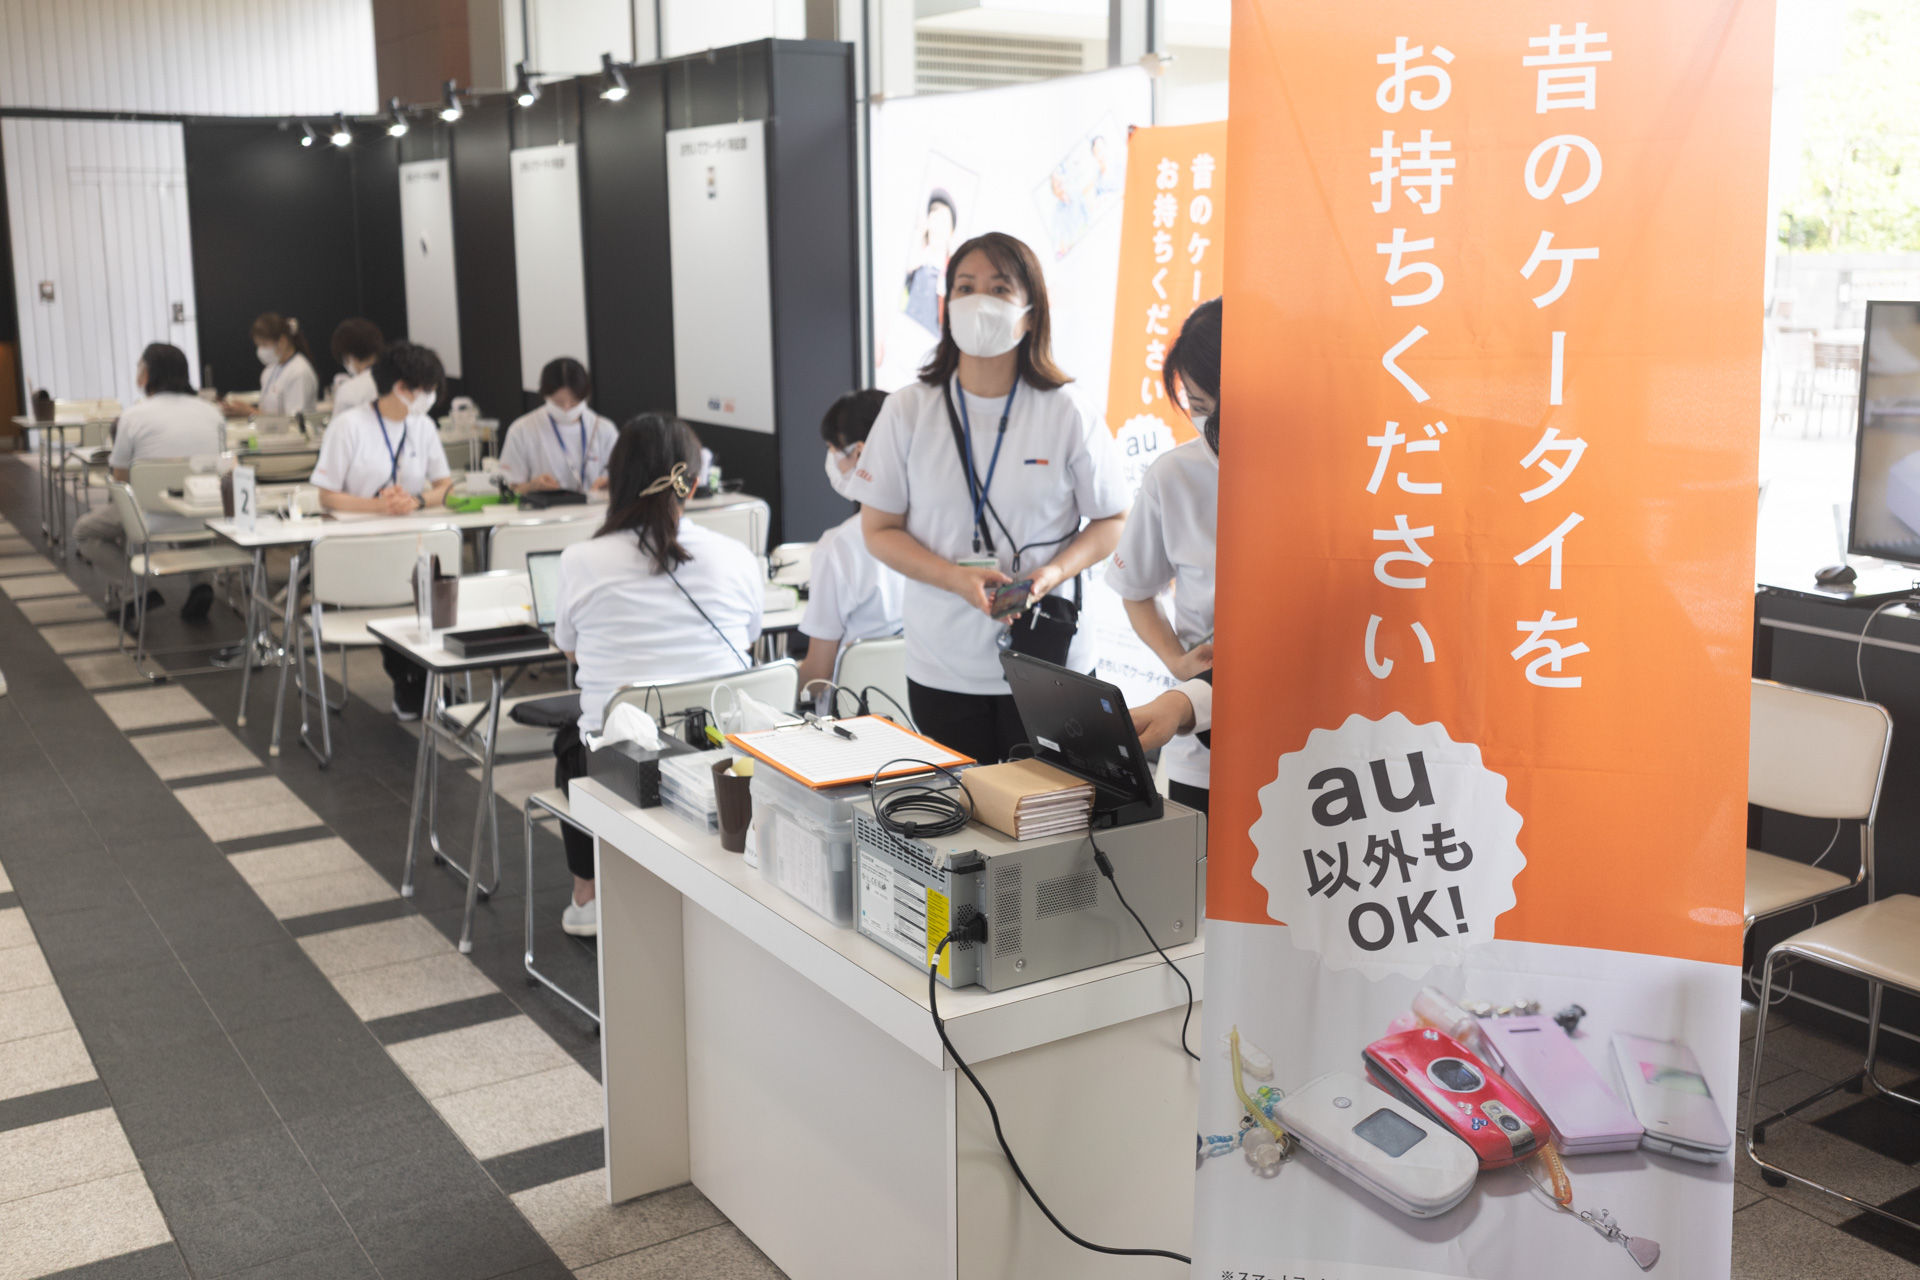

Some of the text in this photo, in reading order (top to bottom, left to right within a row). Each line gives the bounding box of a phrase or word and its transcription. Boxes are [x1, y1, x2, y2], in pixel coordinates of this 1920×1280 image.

[1141, 158, 1179, 405] お持ちください
[1364, 35, 1456, 680] お持ちください
[1511, 22, 1613, 688] 昔のケータイを
[1127, 431, 1158, 457] au
[240, 488, 250, 516] 2
[1308, 751, 1436, 827] au
[1303, 823, 1474, 899] 以外も
[1348, 885, 1469, 952] OK!
